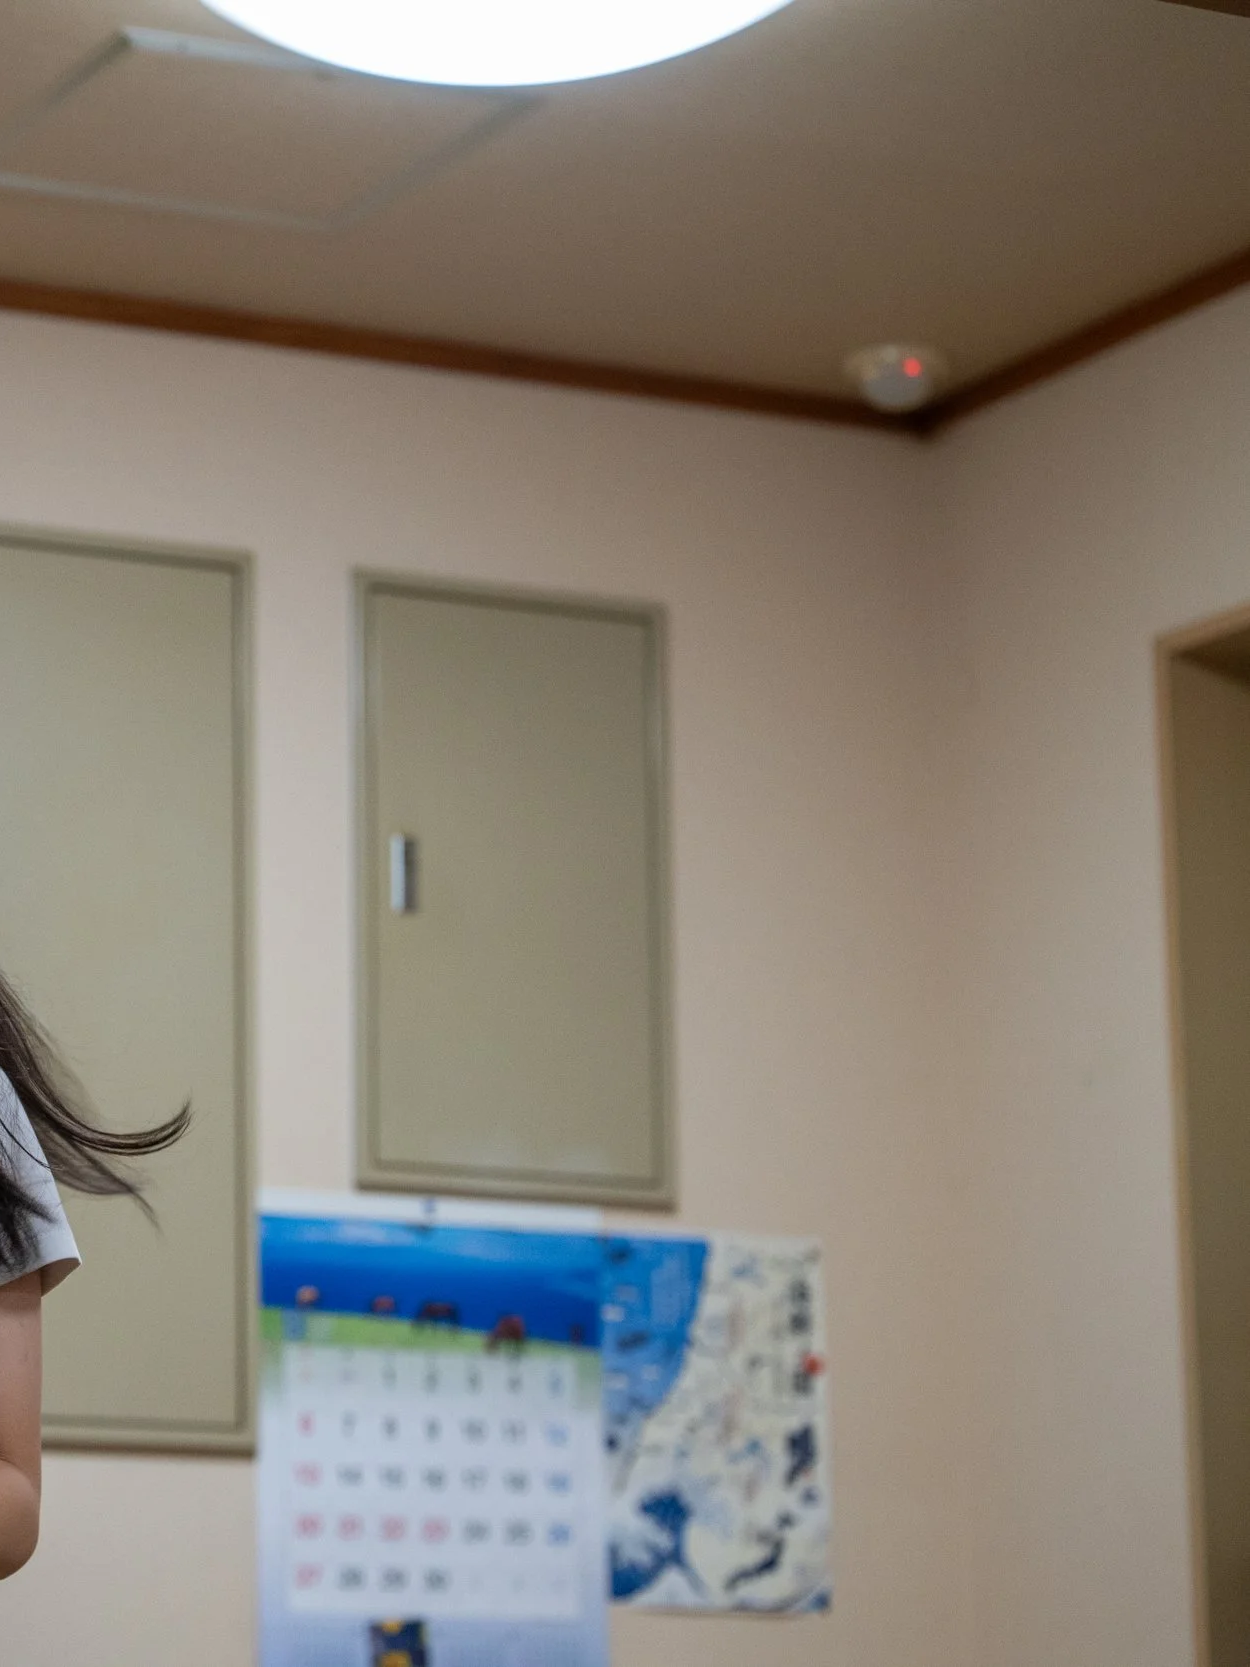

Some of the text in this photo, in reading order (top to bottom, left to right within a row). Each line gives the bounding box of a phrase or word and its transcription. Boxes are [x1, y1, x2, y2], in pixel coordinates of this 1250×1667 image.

[340, 1412, 356, 1438] 7
[461, 1418, 486, 1443] 10
[502, 1420, 527, 1445] 11
[461, 1467, 488, 1492] 17
